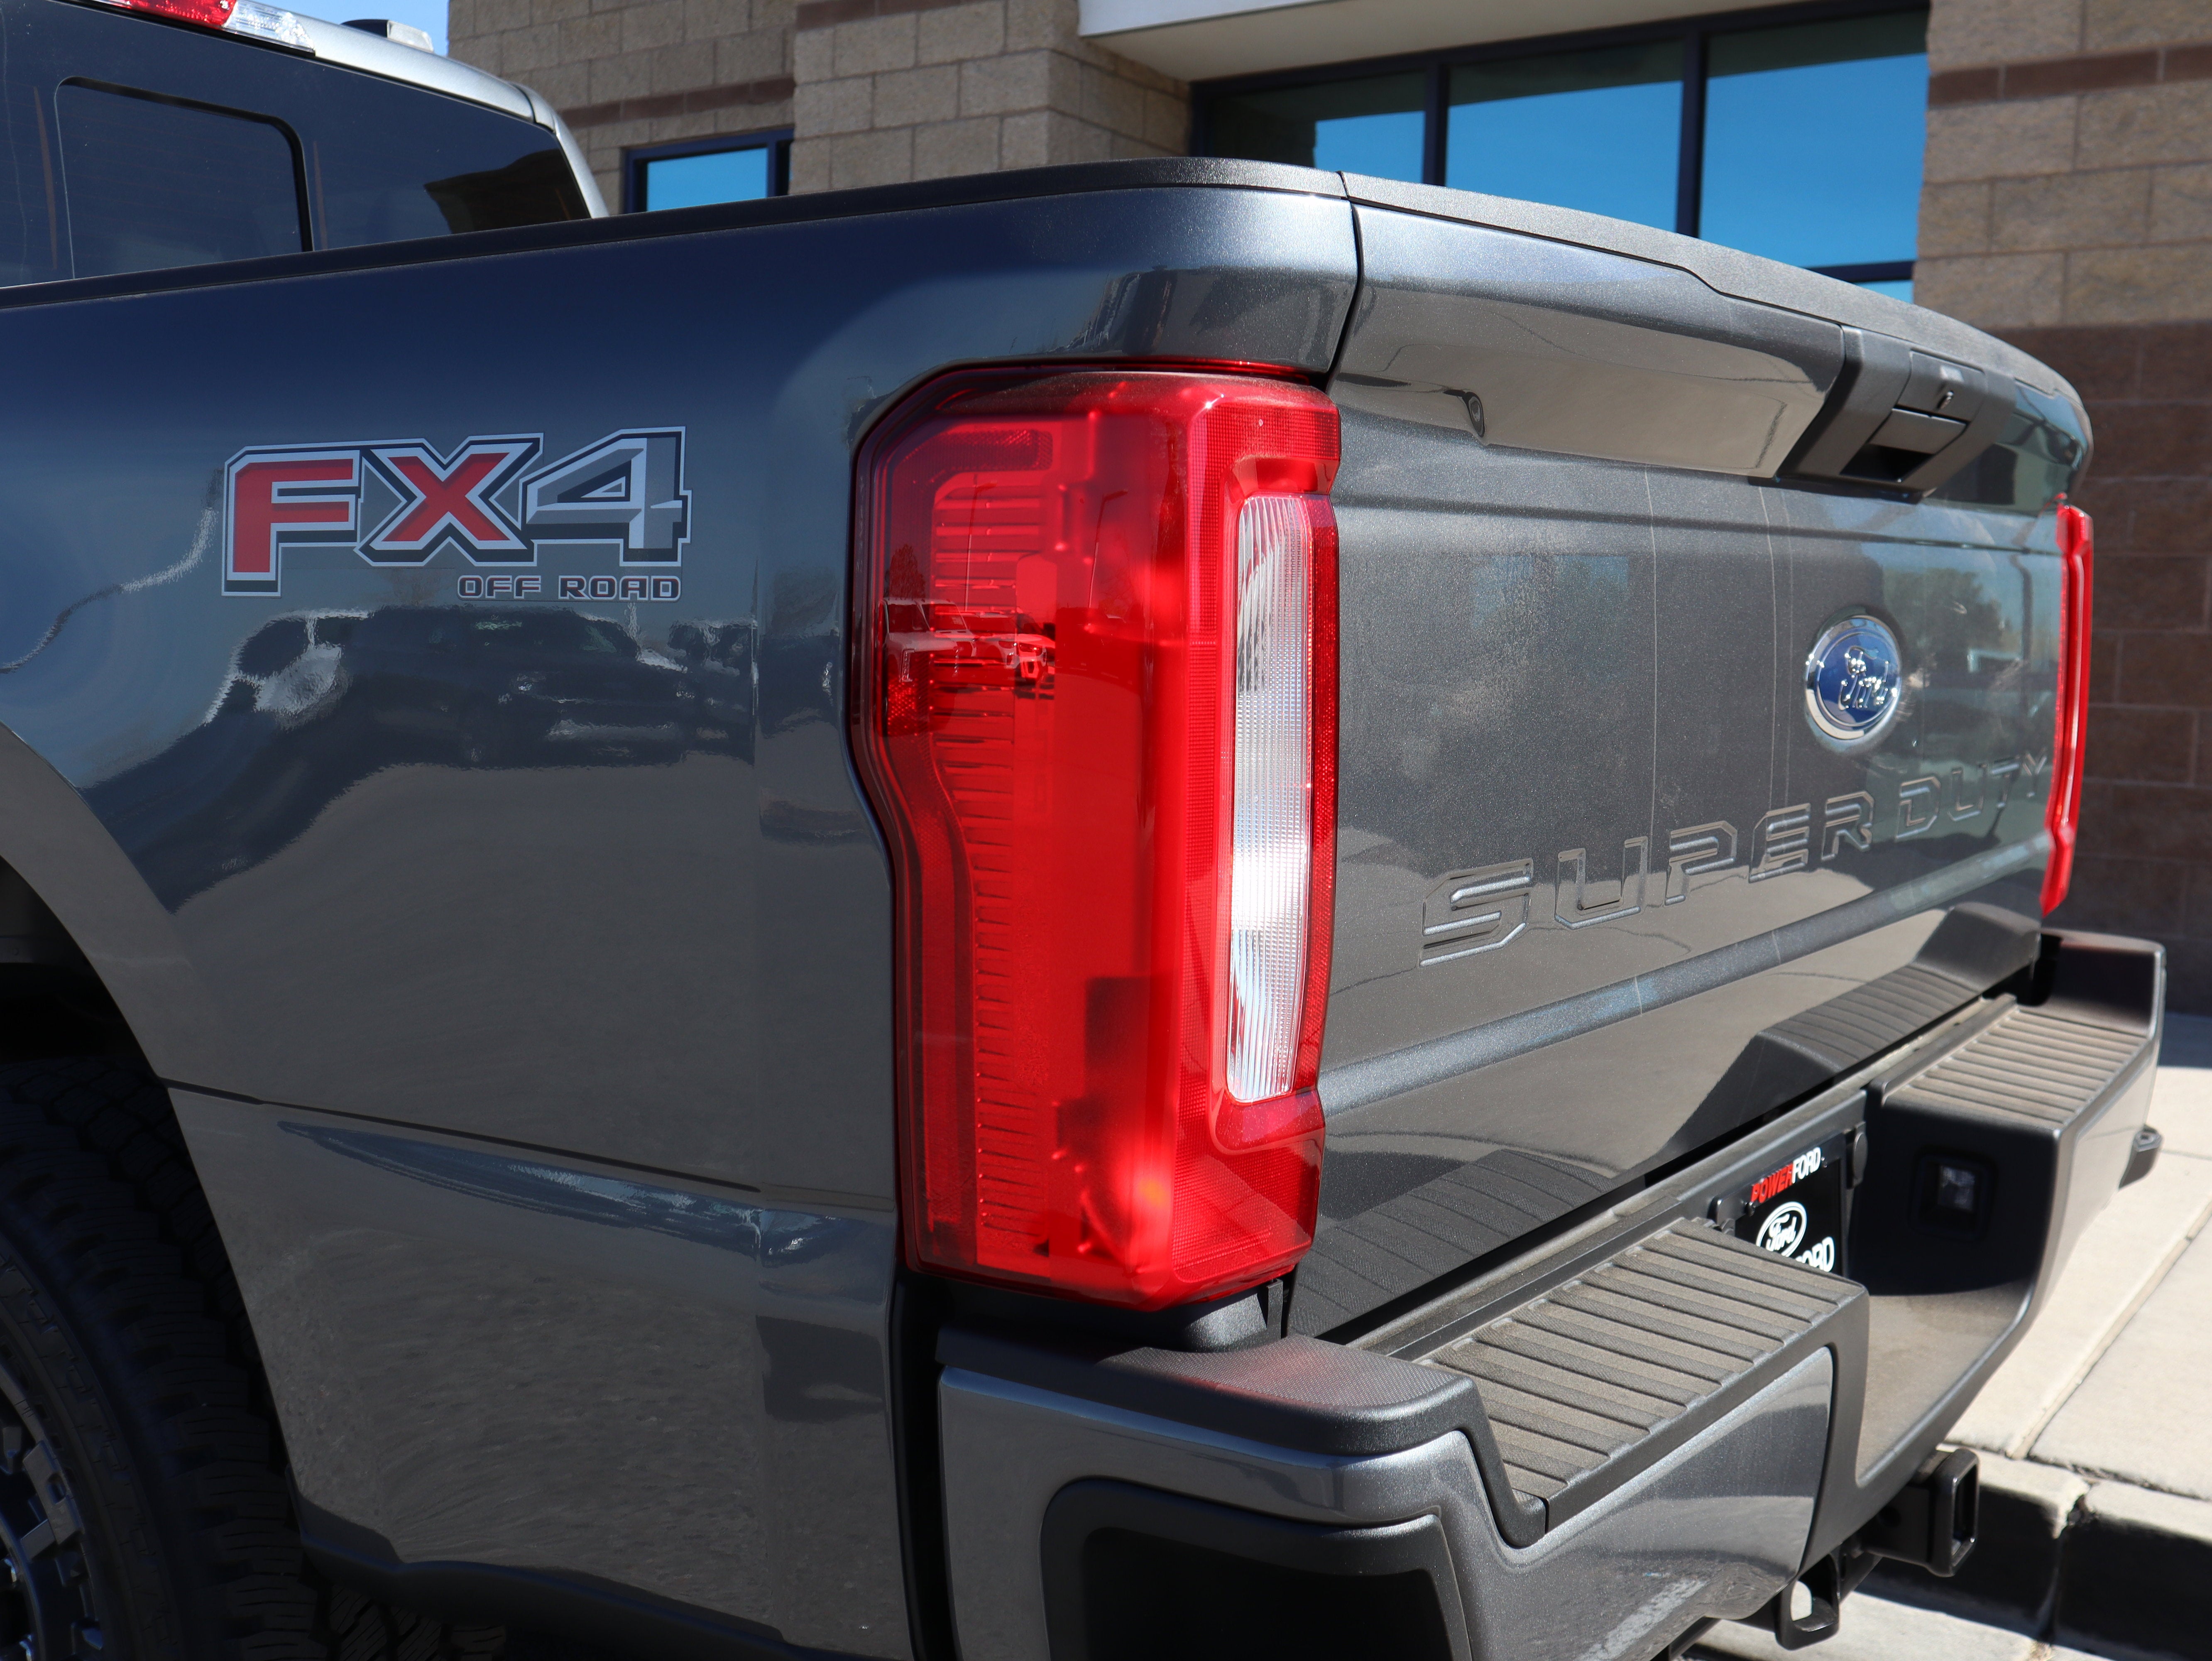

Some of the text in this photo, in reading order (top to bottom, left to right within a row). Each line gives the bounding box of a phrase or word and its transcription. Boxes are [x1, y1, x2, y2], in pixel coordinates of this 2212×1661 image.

[222, 426, 691, 597] FX4
[457, 575, 681, 600] OFF ROAD
[1419, 750, 2048, 967] SUPER DUTY
[1766, 1213, 1797, 1251] Ford
[1795, 1236, 1835, 1272] RD
